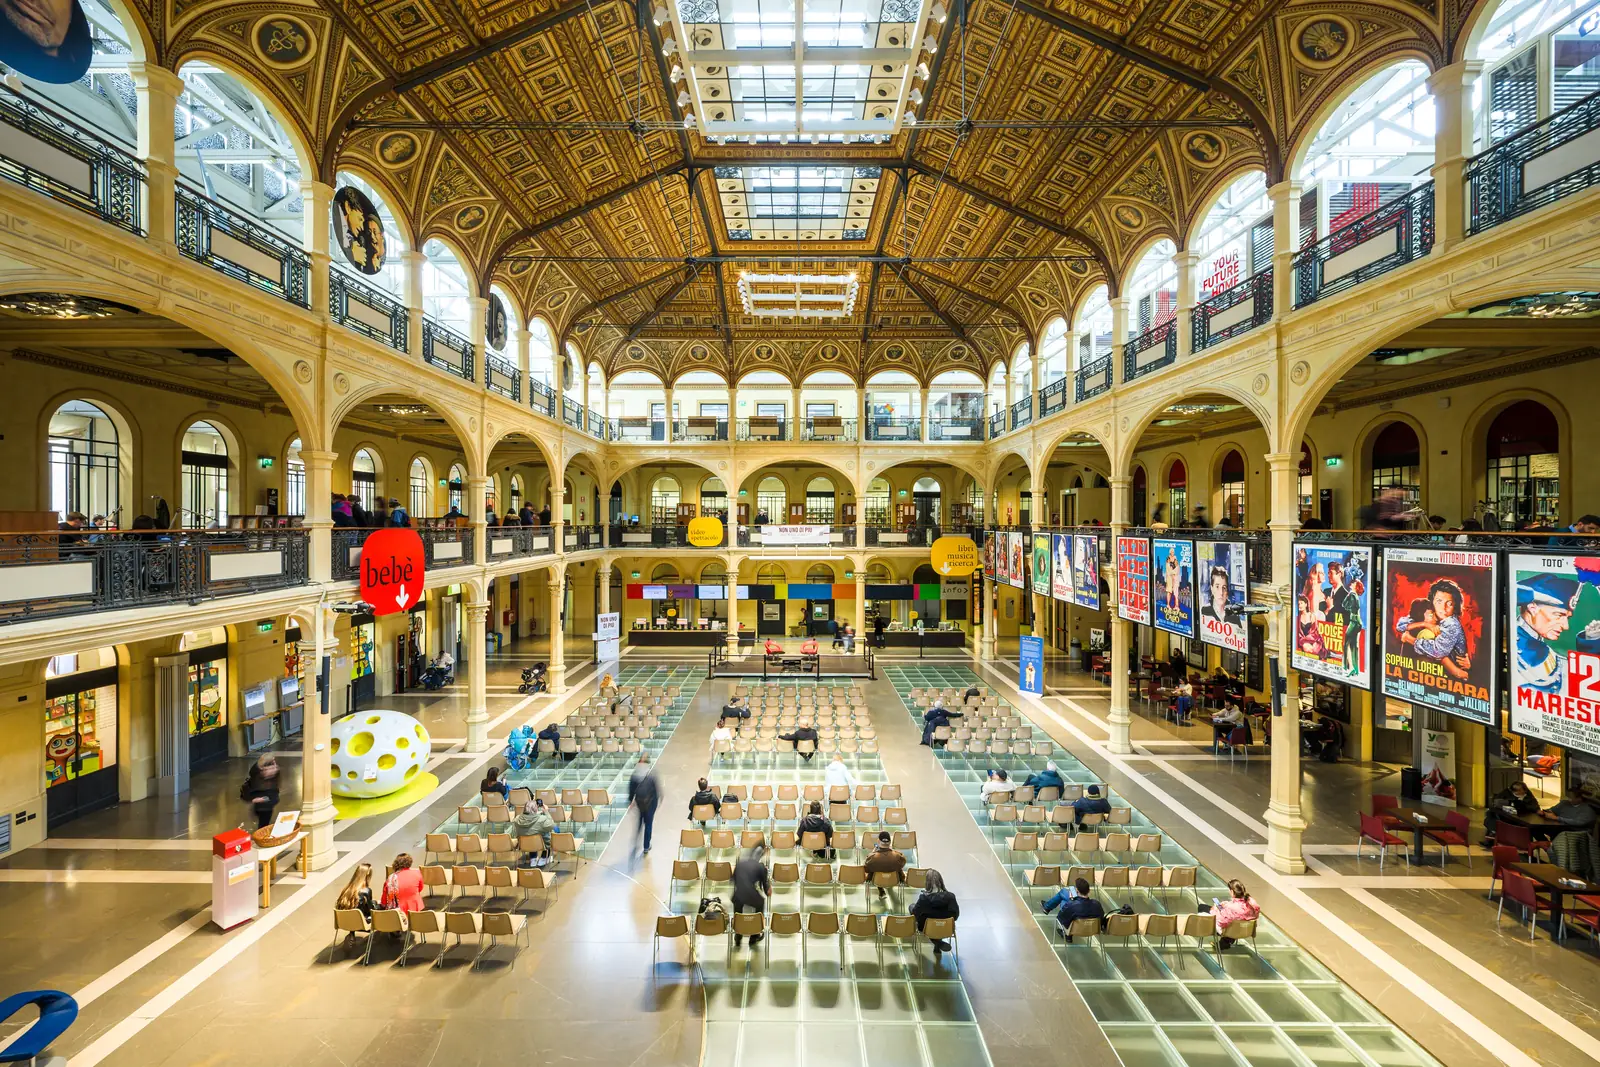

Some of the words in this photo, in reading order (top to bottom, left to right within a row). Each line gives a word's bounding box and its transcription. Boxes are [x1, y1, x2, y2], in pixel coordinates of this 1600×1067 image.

[1213, 249, 1239, 272] YOUR
[1203, 260, 1239, 291] FUTURE
[958, 544, 974, 552] libri
[1440, 552, 1465, 565] VITTORIO
[1467, 553, 1476, 566] DE
[1477, 554, 1493, 567] SICA
[365, 556, 413, 588] bebè
[1335, 612, 1344, 625] LA
[1207, 620, 1233, 637] 400
[1318, 622, 1344, 639] DOLCE
[1225, 634, 1246, 651] colpi
[1324, 636, 1344, 653] VITA
[1385, 652, 1414, 670] SOPHIA
[1416, 660, 1444, 677] LOREN
[1385, 664, 1403, 678] LA
[1408, 670, 1490, 702] CIOCIARA
[1542, 713, 1560, 724] ROLAND
[1542, 720, 1560, 730] FRANCO
[1552, 734, 1569, 744] SERGIO
[1571, 740, 1599, 753] CORBUCCI
